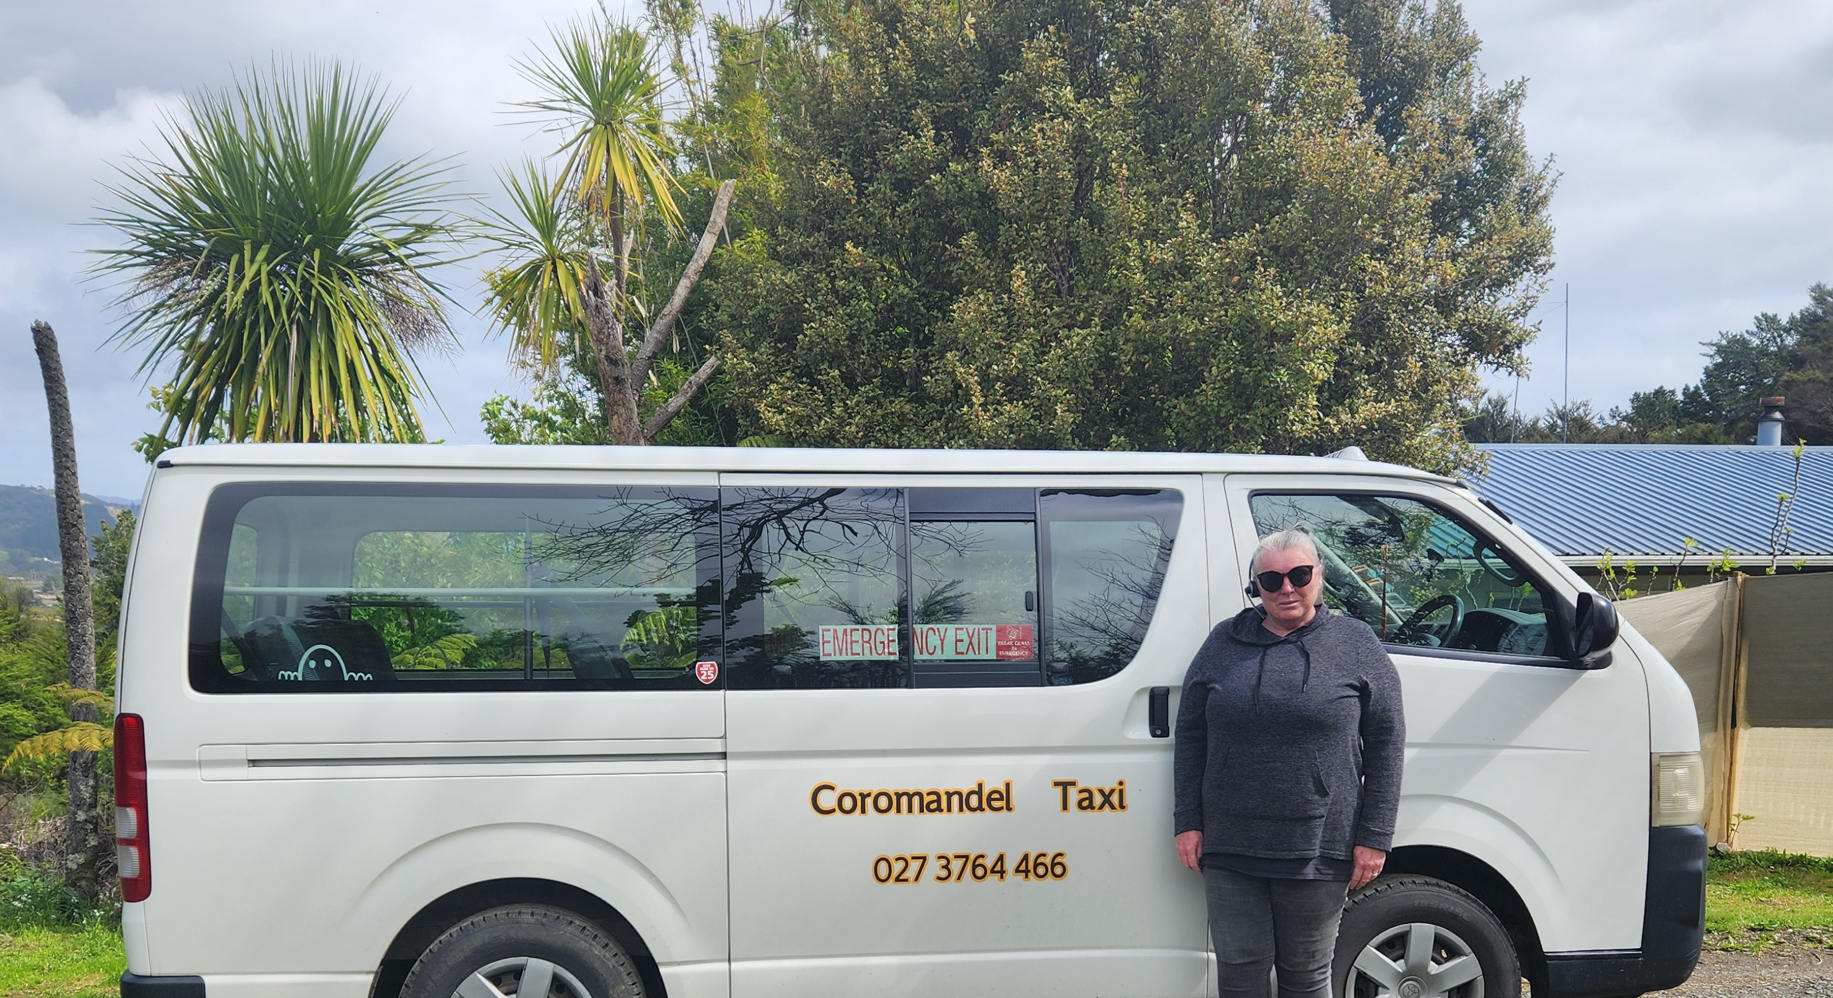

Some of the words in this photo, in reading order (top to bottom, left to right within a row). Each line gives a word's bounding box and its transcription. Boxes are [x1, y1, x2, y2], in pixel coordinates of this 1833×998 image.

[954, 626, 993, 656] EXIT
[700, 670, 714, 680] 25
[809, 780, 1015, 816] Coromandel
[1051, 779, 1129, 813] Taxi
[872, 853, 929, 883] 027
[933, 852, 1008, 883] 3764
[1013, 851, 1069, 882] 466
